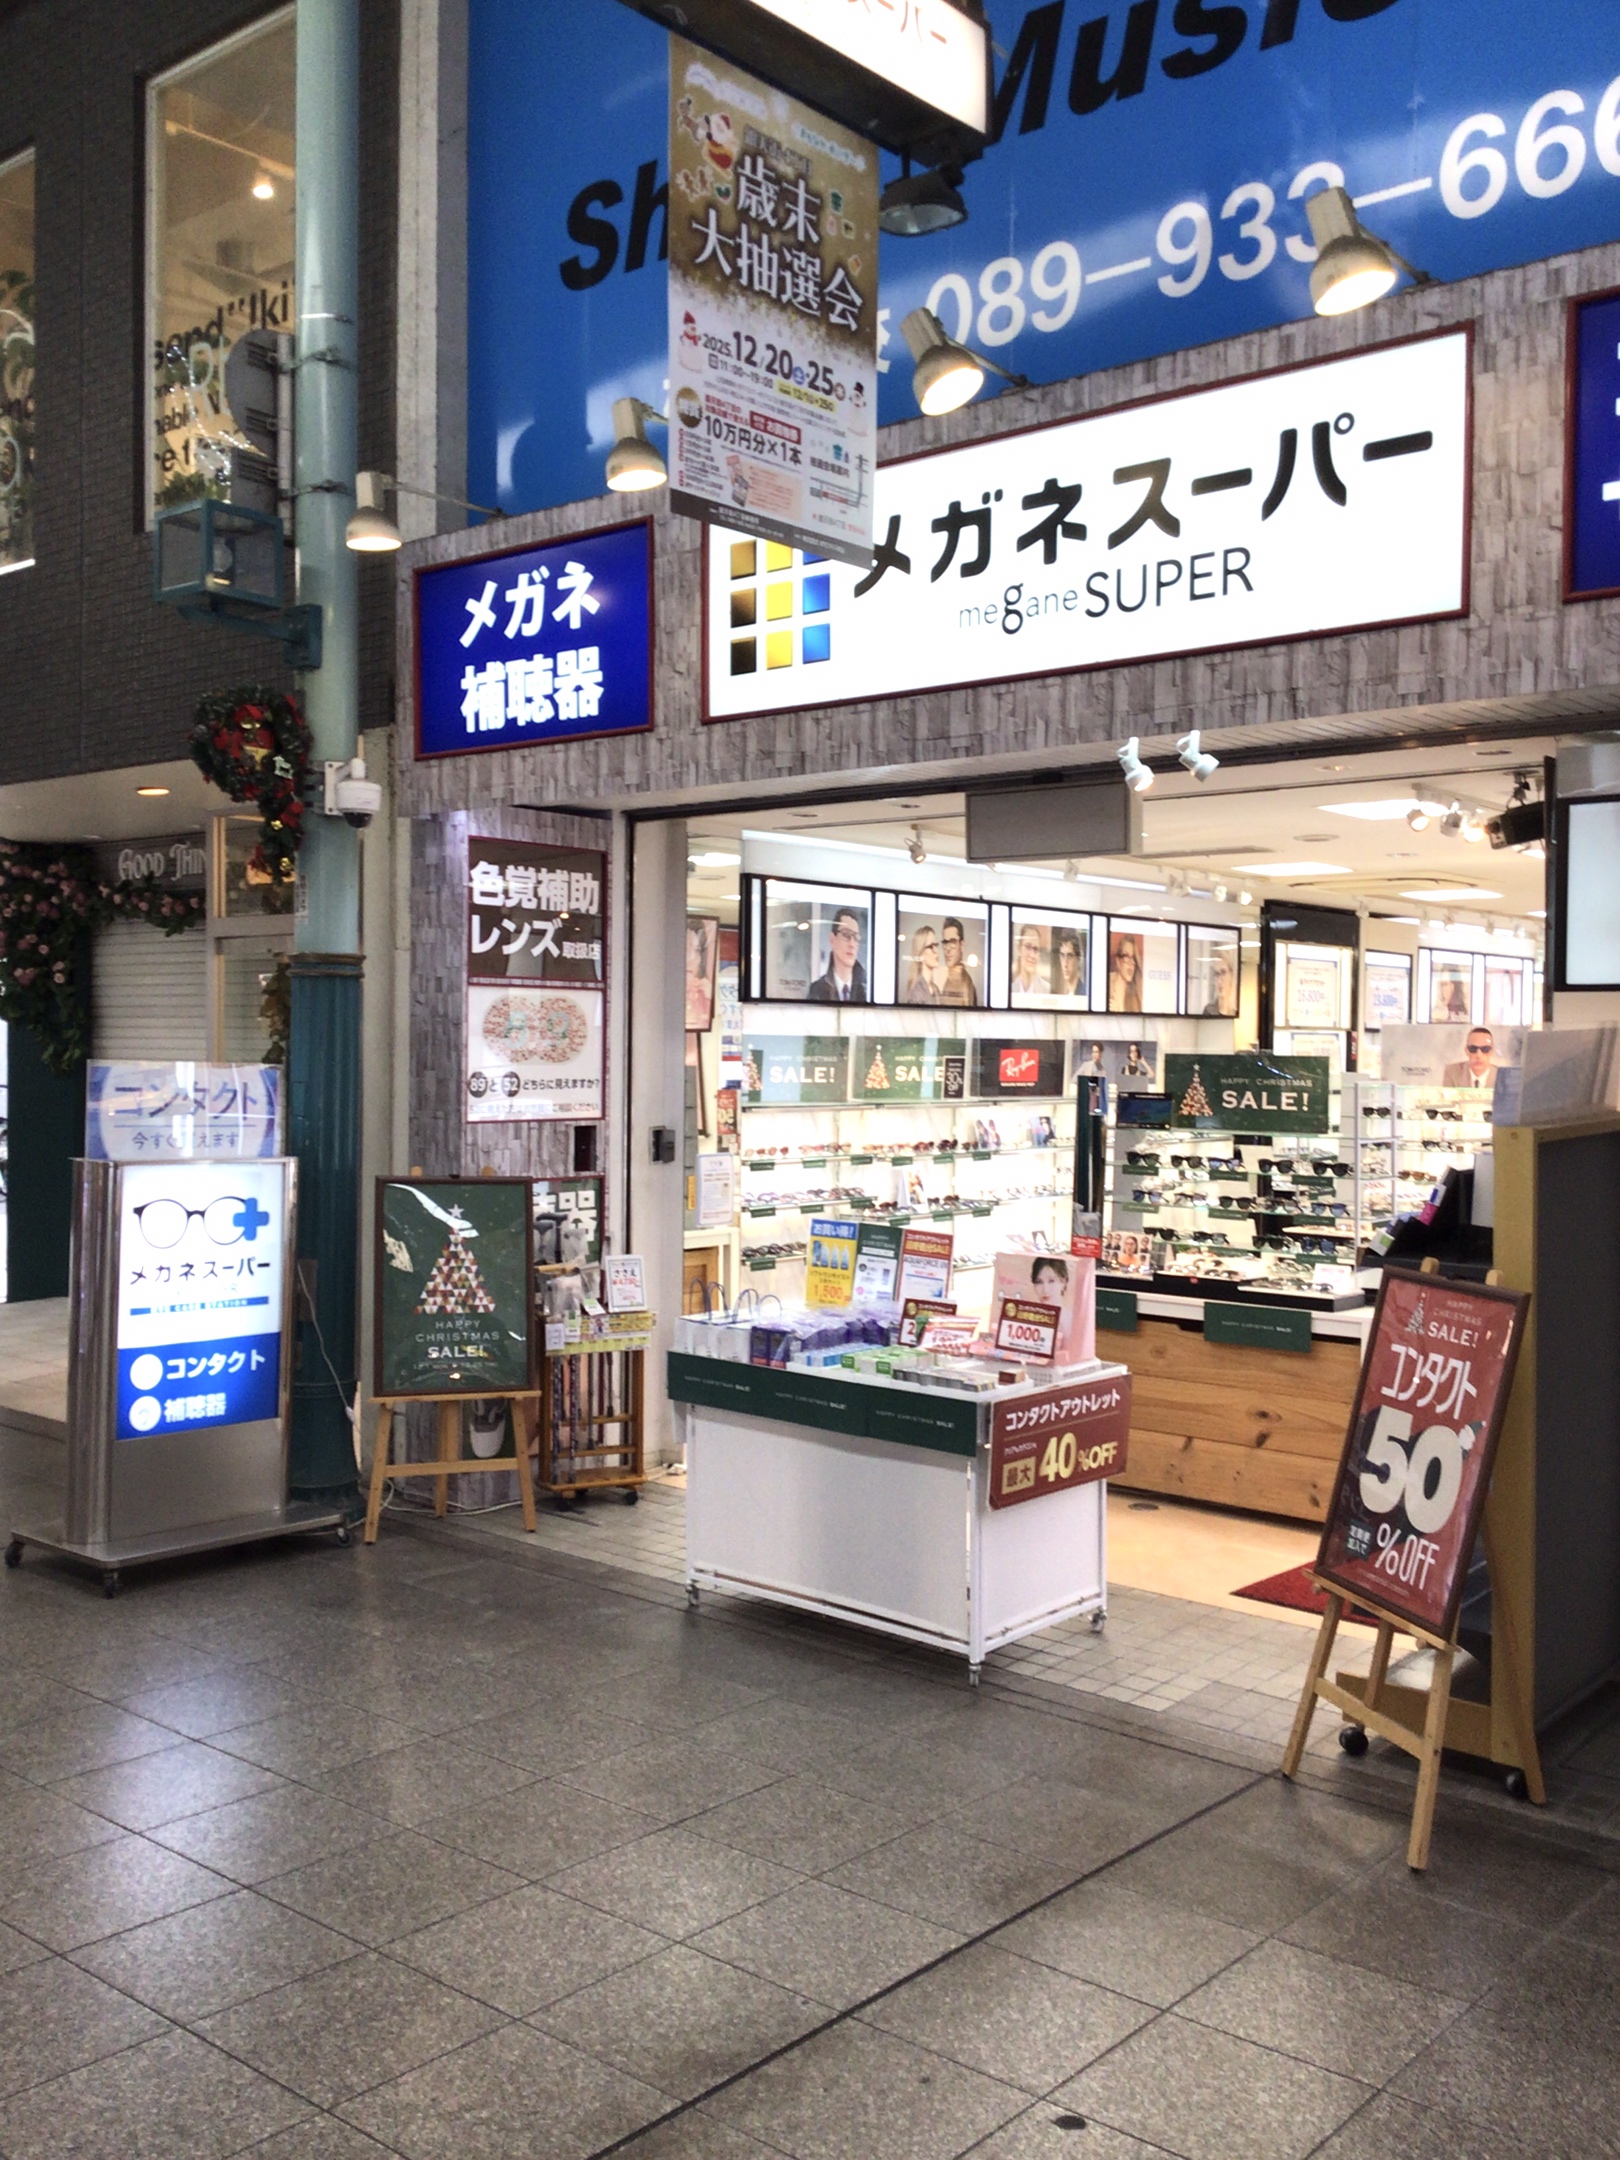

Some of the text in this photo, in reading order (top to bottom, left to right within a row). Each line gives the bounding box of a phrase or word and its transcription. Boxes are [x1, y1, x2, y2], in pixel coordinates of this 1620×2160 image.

[738, 155, 821, 243] 歳末
[692, 208, 863, 331] 大抽選会
[854, 411, 1433, 598] メガネスーパー
[459, 561, 600, 648] メガネ
[460, 646, 604, 733] 補聴器
[470, 860, 600, 915] 色覚補助
[471, 914, 562, 958] レンズ
[769, 1066, 835, 1083] SALE!
[1220, 1077, 1313, 1087] HAPPY CHRISTMAS
[1222, 1091, 1309, 1111] SALE!
[435, 1320, 481, 1330] HAPPY
[1427, 1321, 1479, 1349] SALE!
[1432, 1308, 1483, 1326] CHRISTMAS
[415, 1331, 500, 1343] CHRISTMAS
[428, 1345, 485, 1359] SALE!
[166, 1349, 266, 1380] コンタクト
[1380, 1343, 1478, 1420] コンタクト
[164, 1392, 227, 1423] 補聴器
[1005, 1388, 1121, 1431] コンタクトアウトレット
[1006, 1463, 1032, 1489] 最大
[1359, 1404, 1463, 1534] 50
[1375, 1522, 1440, 1591] %OFF
